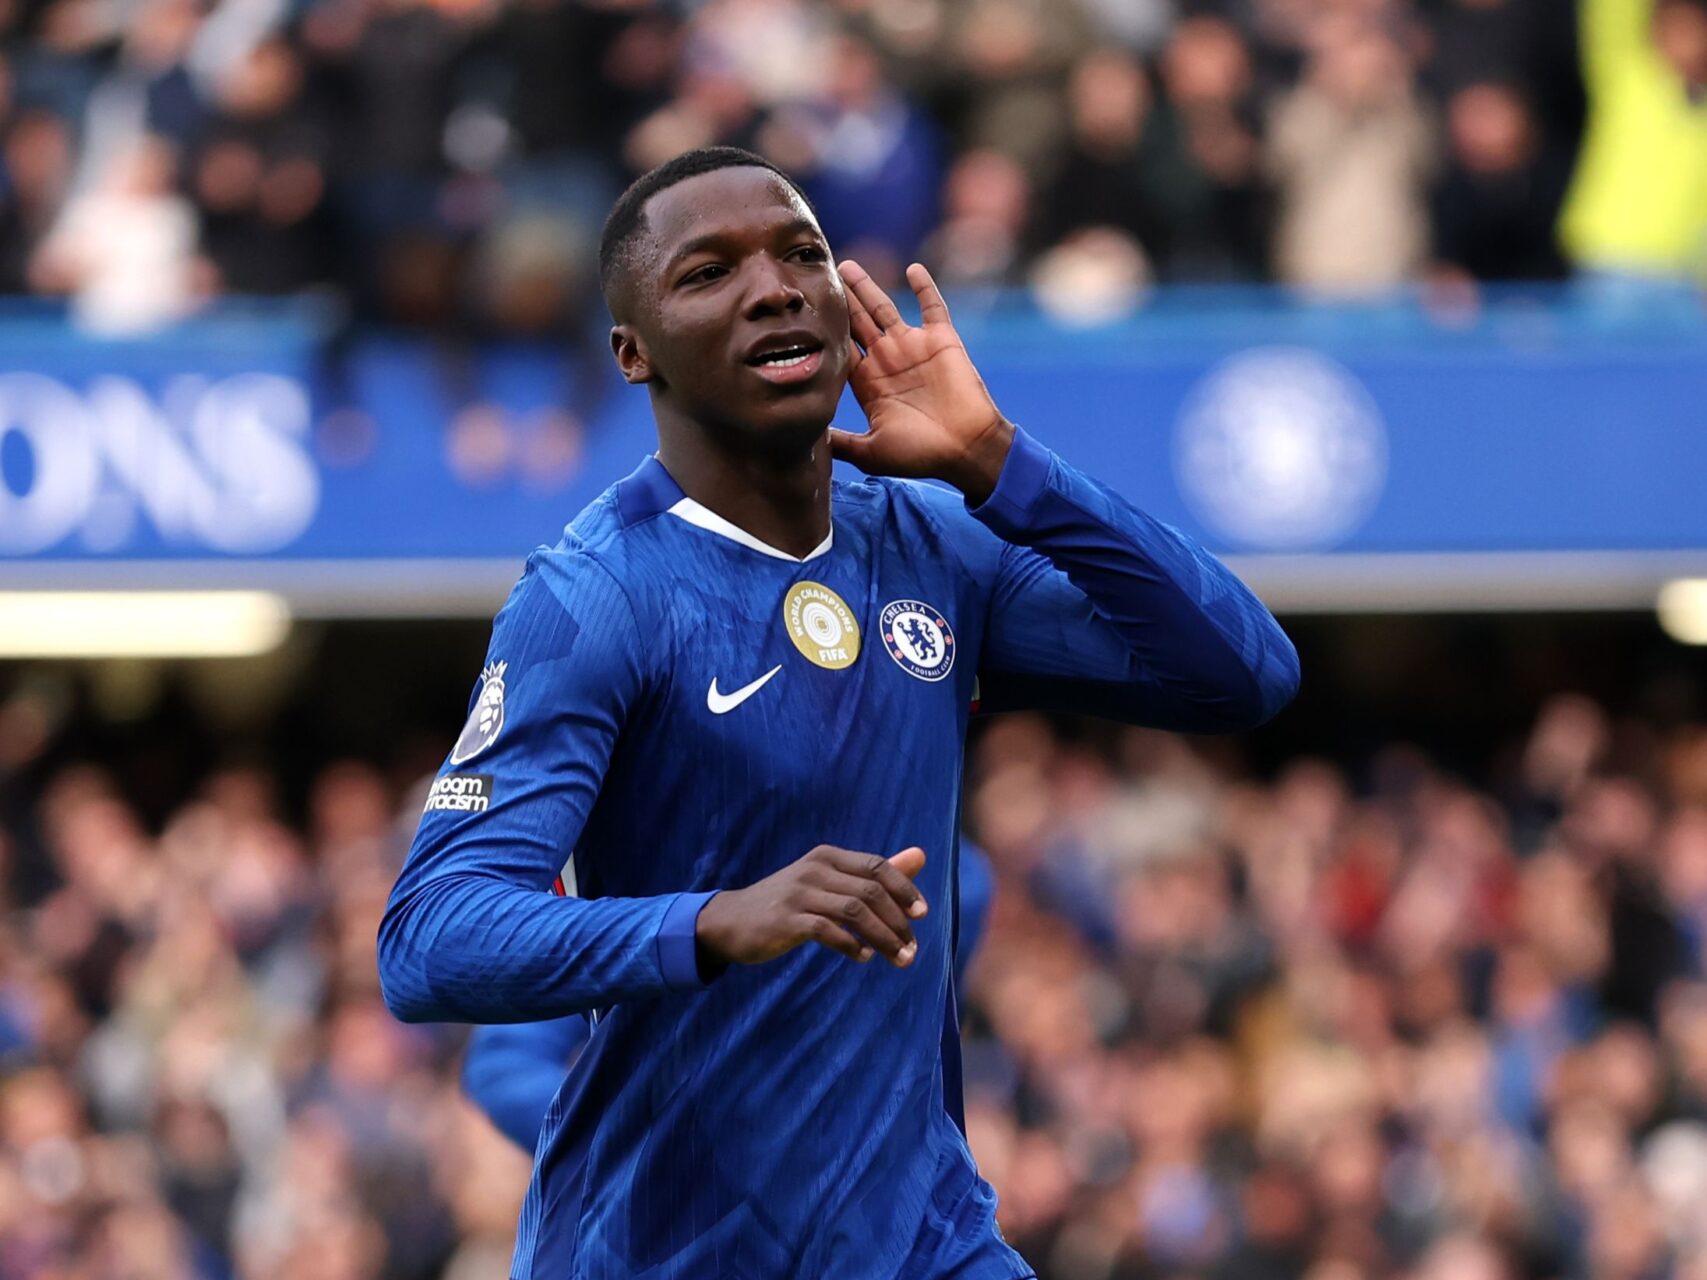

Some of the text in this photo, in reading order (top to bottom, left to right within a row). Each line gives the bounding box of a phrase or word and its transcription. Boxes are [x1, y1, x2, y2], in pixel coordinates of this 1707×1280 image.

[791, 588, 853, 637] WORLD CHAMPIONS
[884, 602, 926, 625] CHELSEA
[818, 647, 849, 662] FIFA
[910, 664, 941, 677] FOOTBALL
